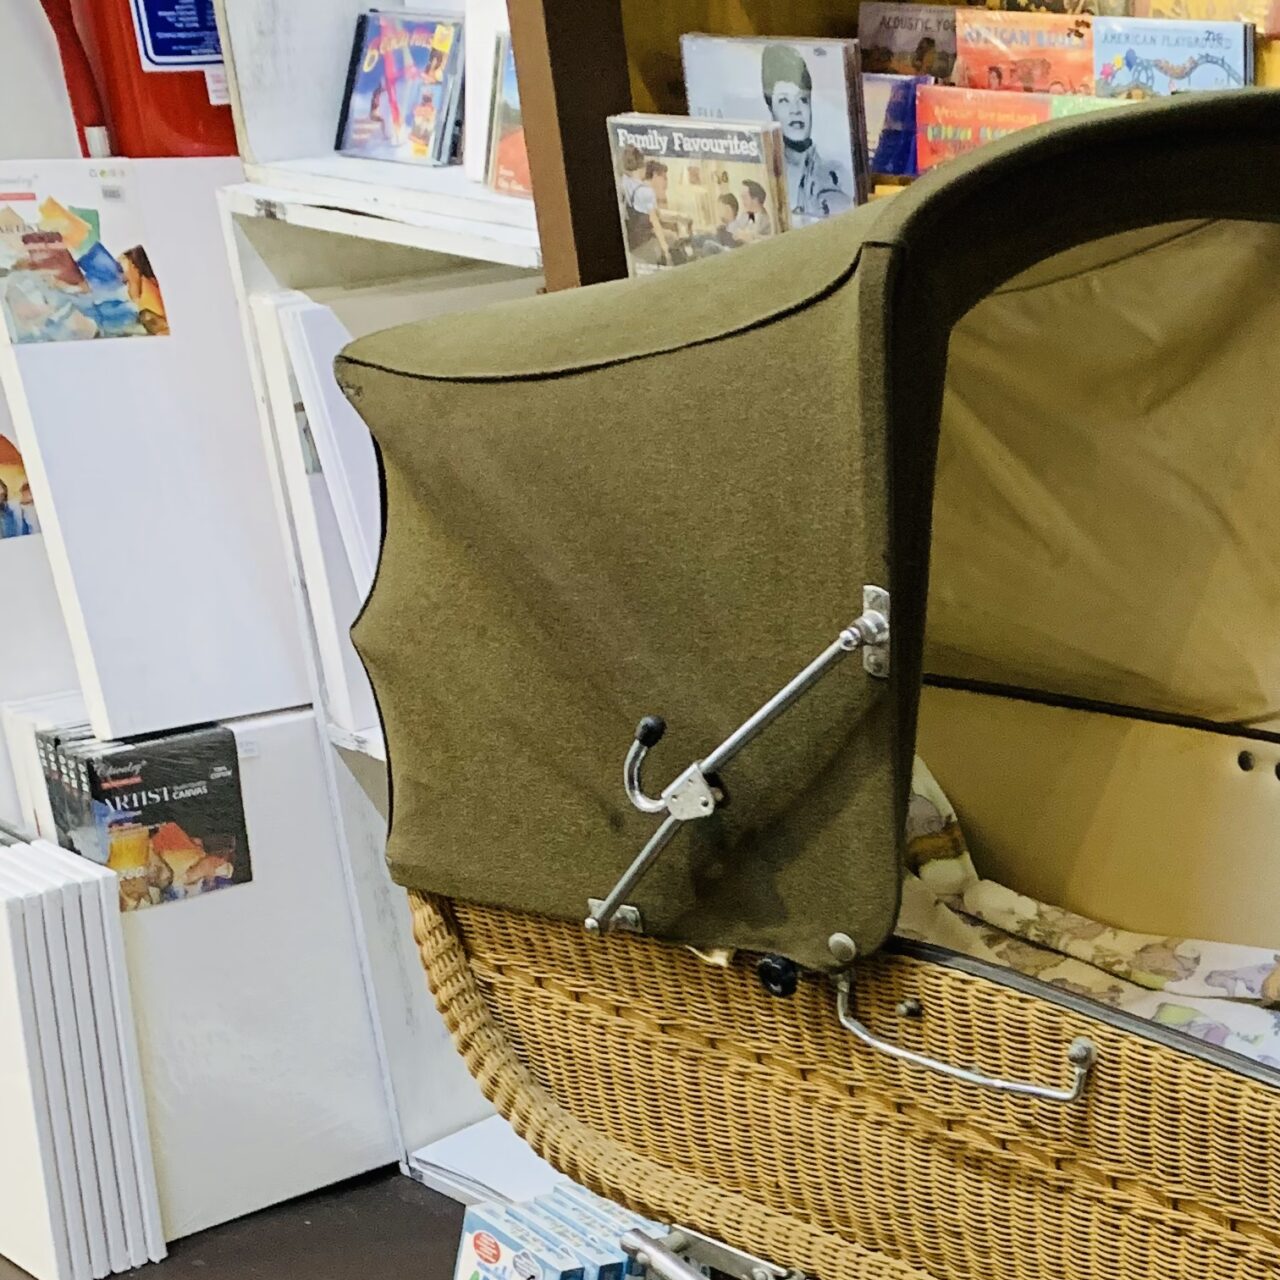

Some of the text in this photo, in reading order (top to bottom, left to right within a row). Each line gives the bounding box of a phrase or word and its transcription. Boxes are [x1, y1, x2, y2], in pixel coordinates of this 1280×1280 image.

[937, 19, 957, 32] YO
[617, 128, 758, 156] Family Favourites
[104, 786, 208, 812] ARTIST CANVAS
